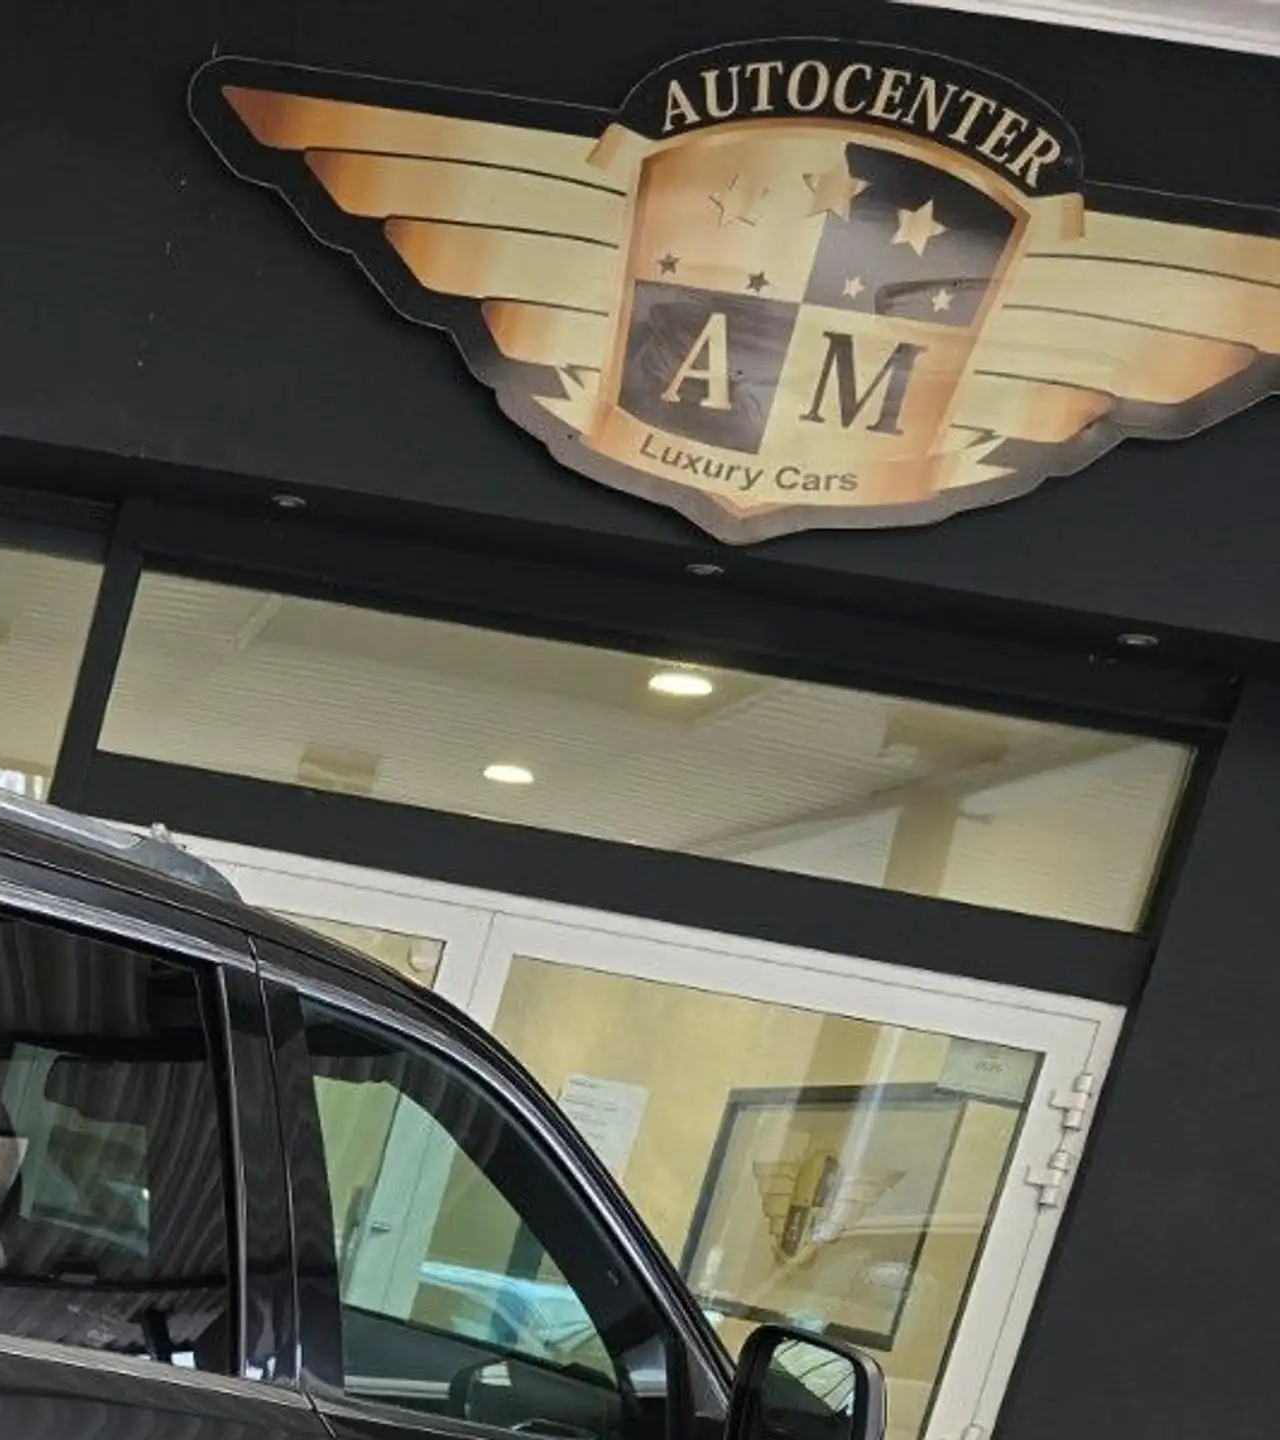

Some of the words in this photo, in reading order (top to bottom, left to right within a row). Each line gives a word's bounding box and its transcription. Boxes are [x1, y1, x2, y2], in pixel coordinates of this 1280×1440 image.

[662, 59, 1062, 189] AUTOCENTER
[639, 433, 765, 491] Luxury
[774, 465, 859, 492] Cars
